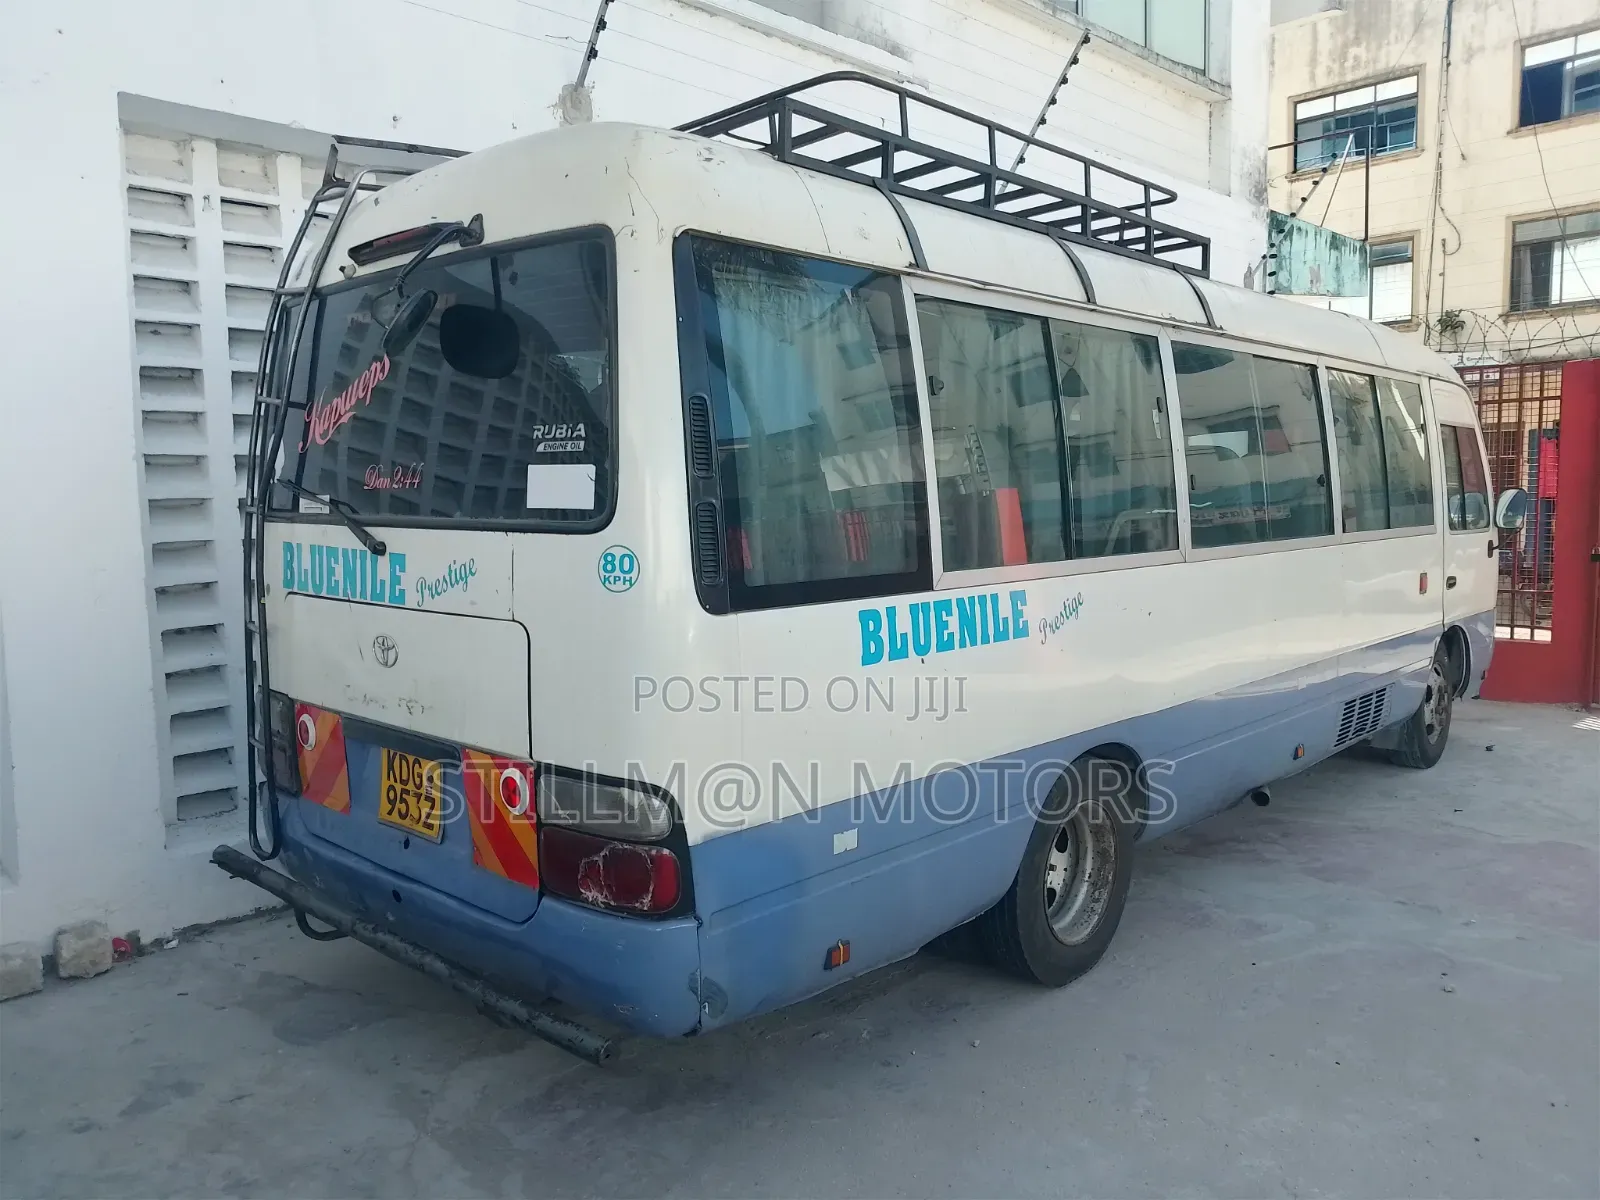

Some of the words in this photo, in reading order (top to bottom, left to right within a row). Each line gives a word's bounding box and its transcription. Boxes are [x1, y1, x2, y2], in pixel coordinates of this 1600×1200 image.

[543, 442, 569, 451] ENGINE
[570, 441, 583, 450] OIL
[364, 464, 390, 490] Dan
[392, 462, 425, 489] 2:44
[283, 541, 406, 605] BLUENILE
[416, 558, 477, 607] Prestige
[602, 552, 635, 575] 80
[603, 575, 633, 587] KPH
[858, 589, 1030, 666] BLUENILE
[1038, 591, 1084, 645] Prestige
[386, 749, 423, 790] KDG
